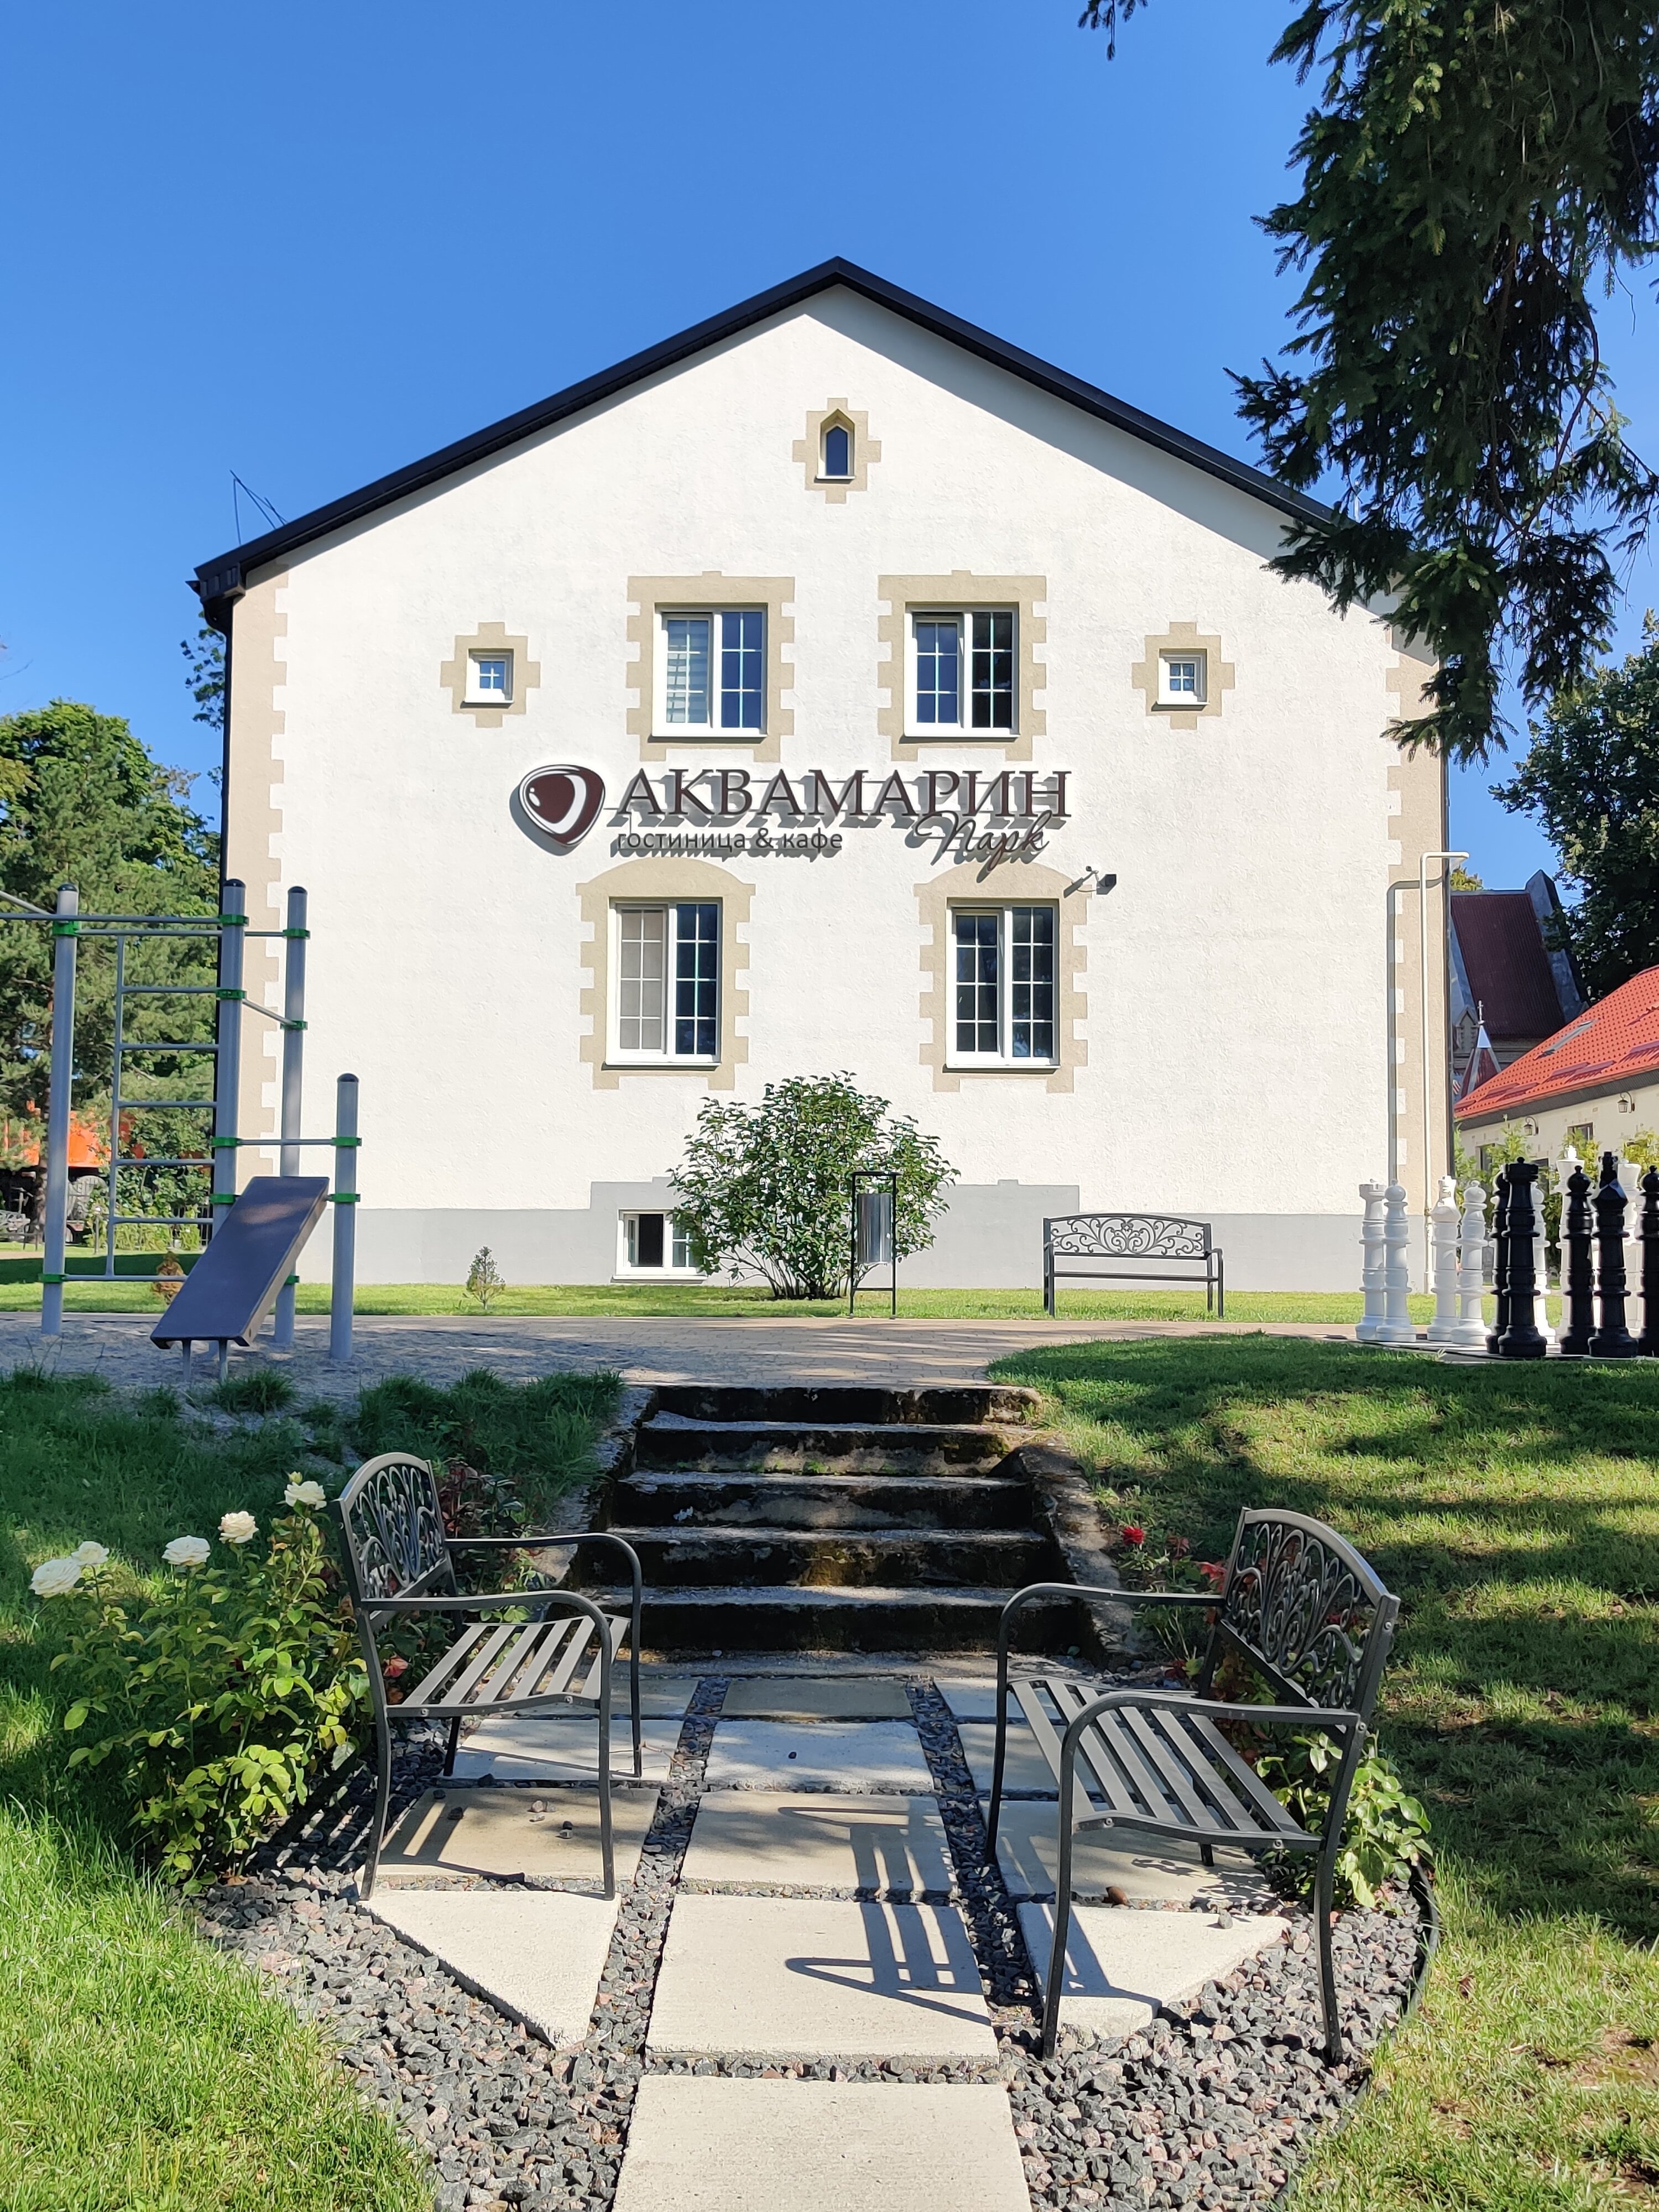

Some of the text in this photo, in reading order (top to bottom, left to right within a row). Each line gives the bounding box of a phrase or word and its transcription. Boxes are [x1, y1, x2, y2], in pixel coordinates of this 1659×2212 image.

[617, 768, 1072, 817] АКВАМАРИН
[618, 827, 843, 853] гостиница & кафе
[915, 810, 1052, 872] Парк
